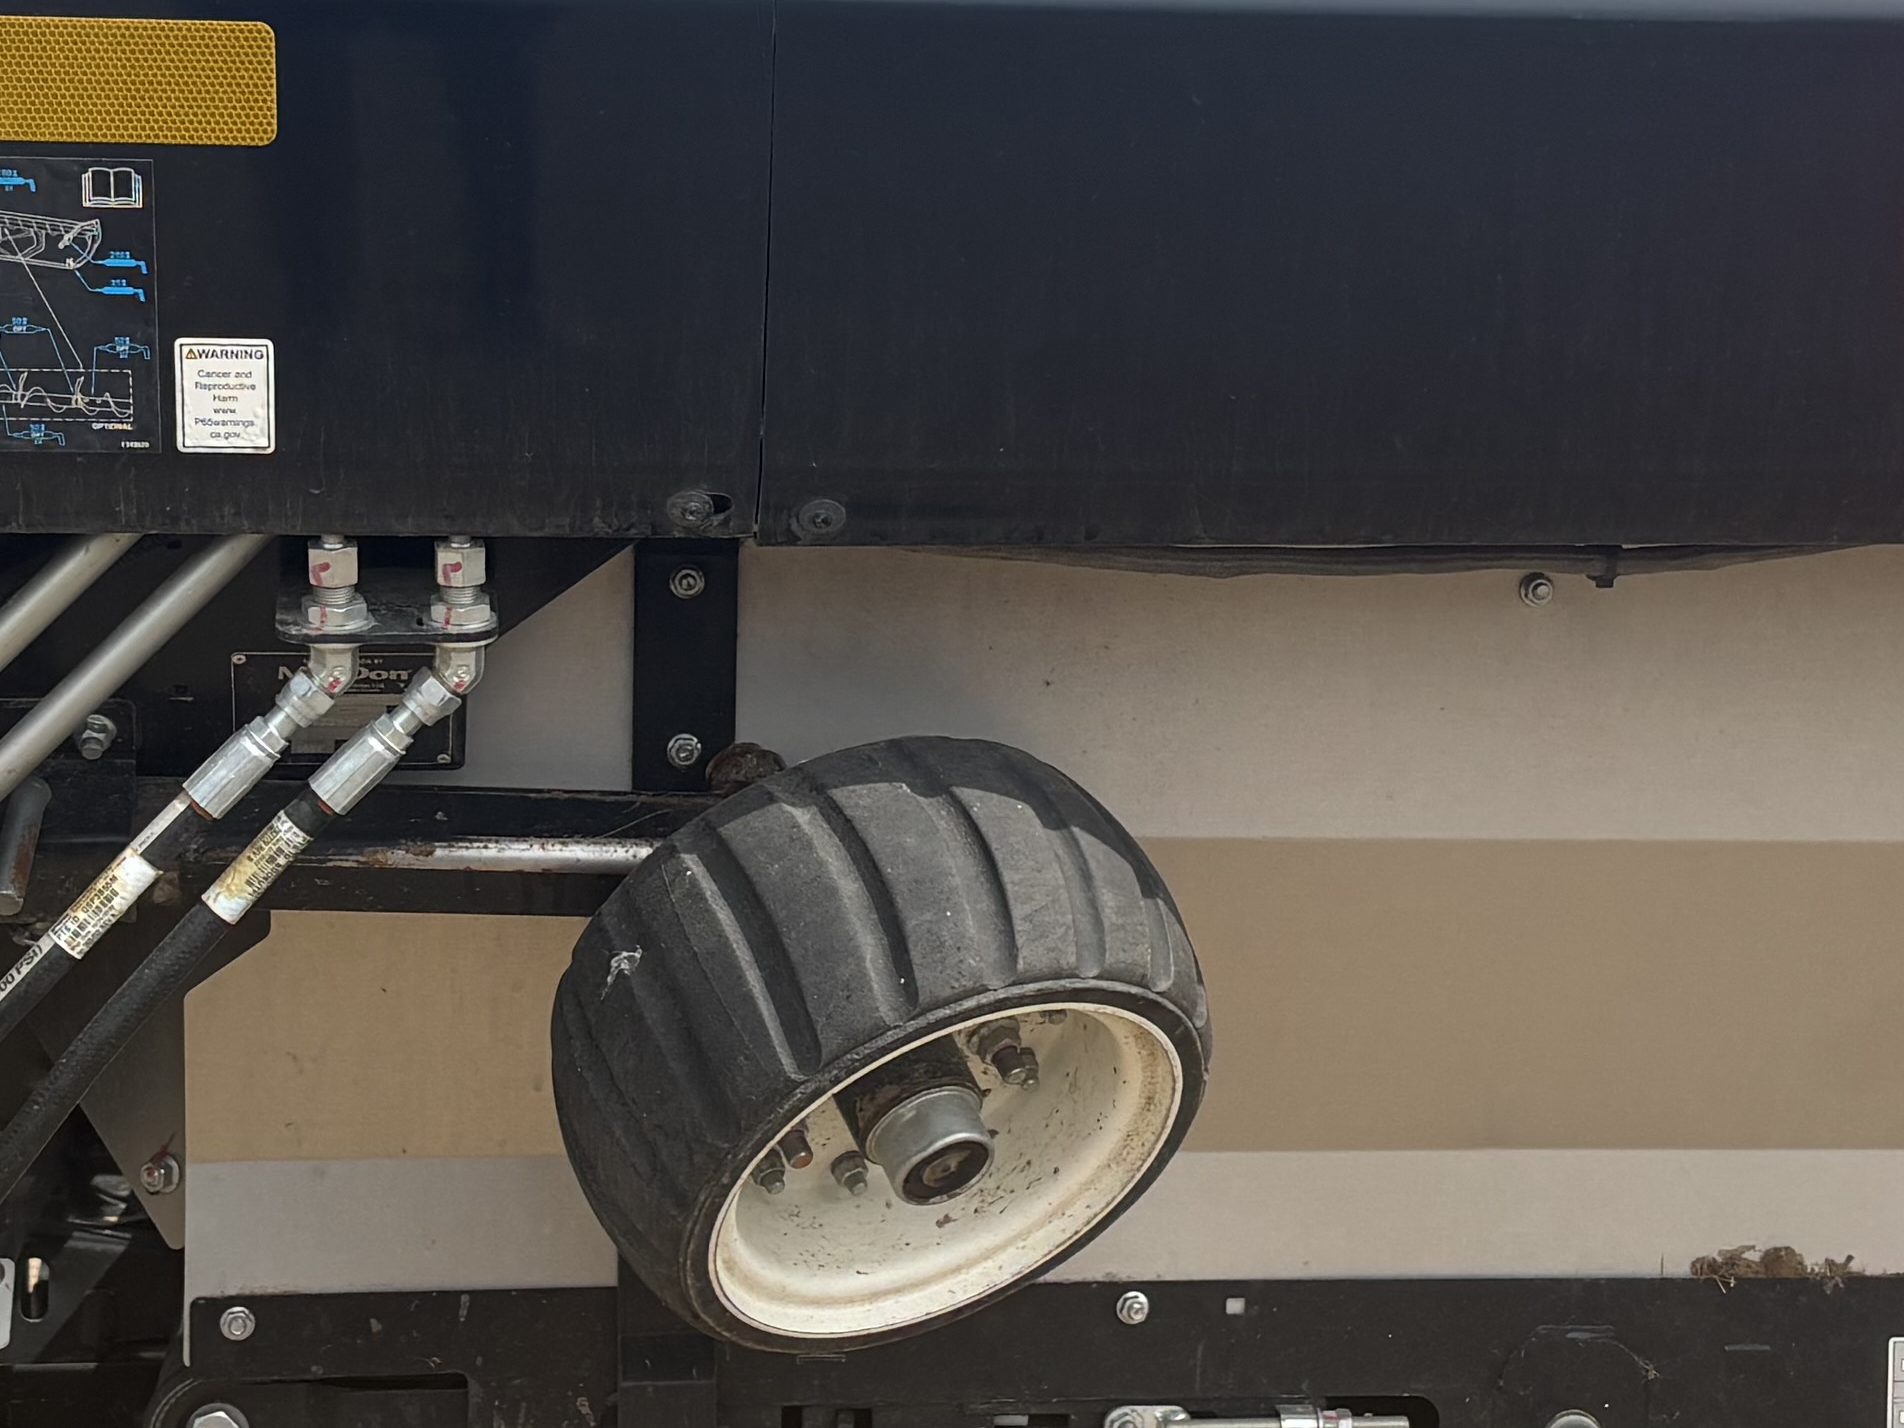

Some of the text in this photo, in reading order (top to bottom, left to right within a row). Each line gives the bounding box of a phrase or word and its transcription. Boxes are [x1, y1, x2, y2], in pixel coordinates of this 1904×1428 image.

[196, 349, 264, 360] WARNING
[197, 369, 231, 378] Cancer
[195, 381, 256, 391] Reproductive
[213, 394, 238, 402] Harm
[14, 943, 43, 975] PSI)
